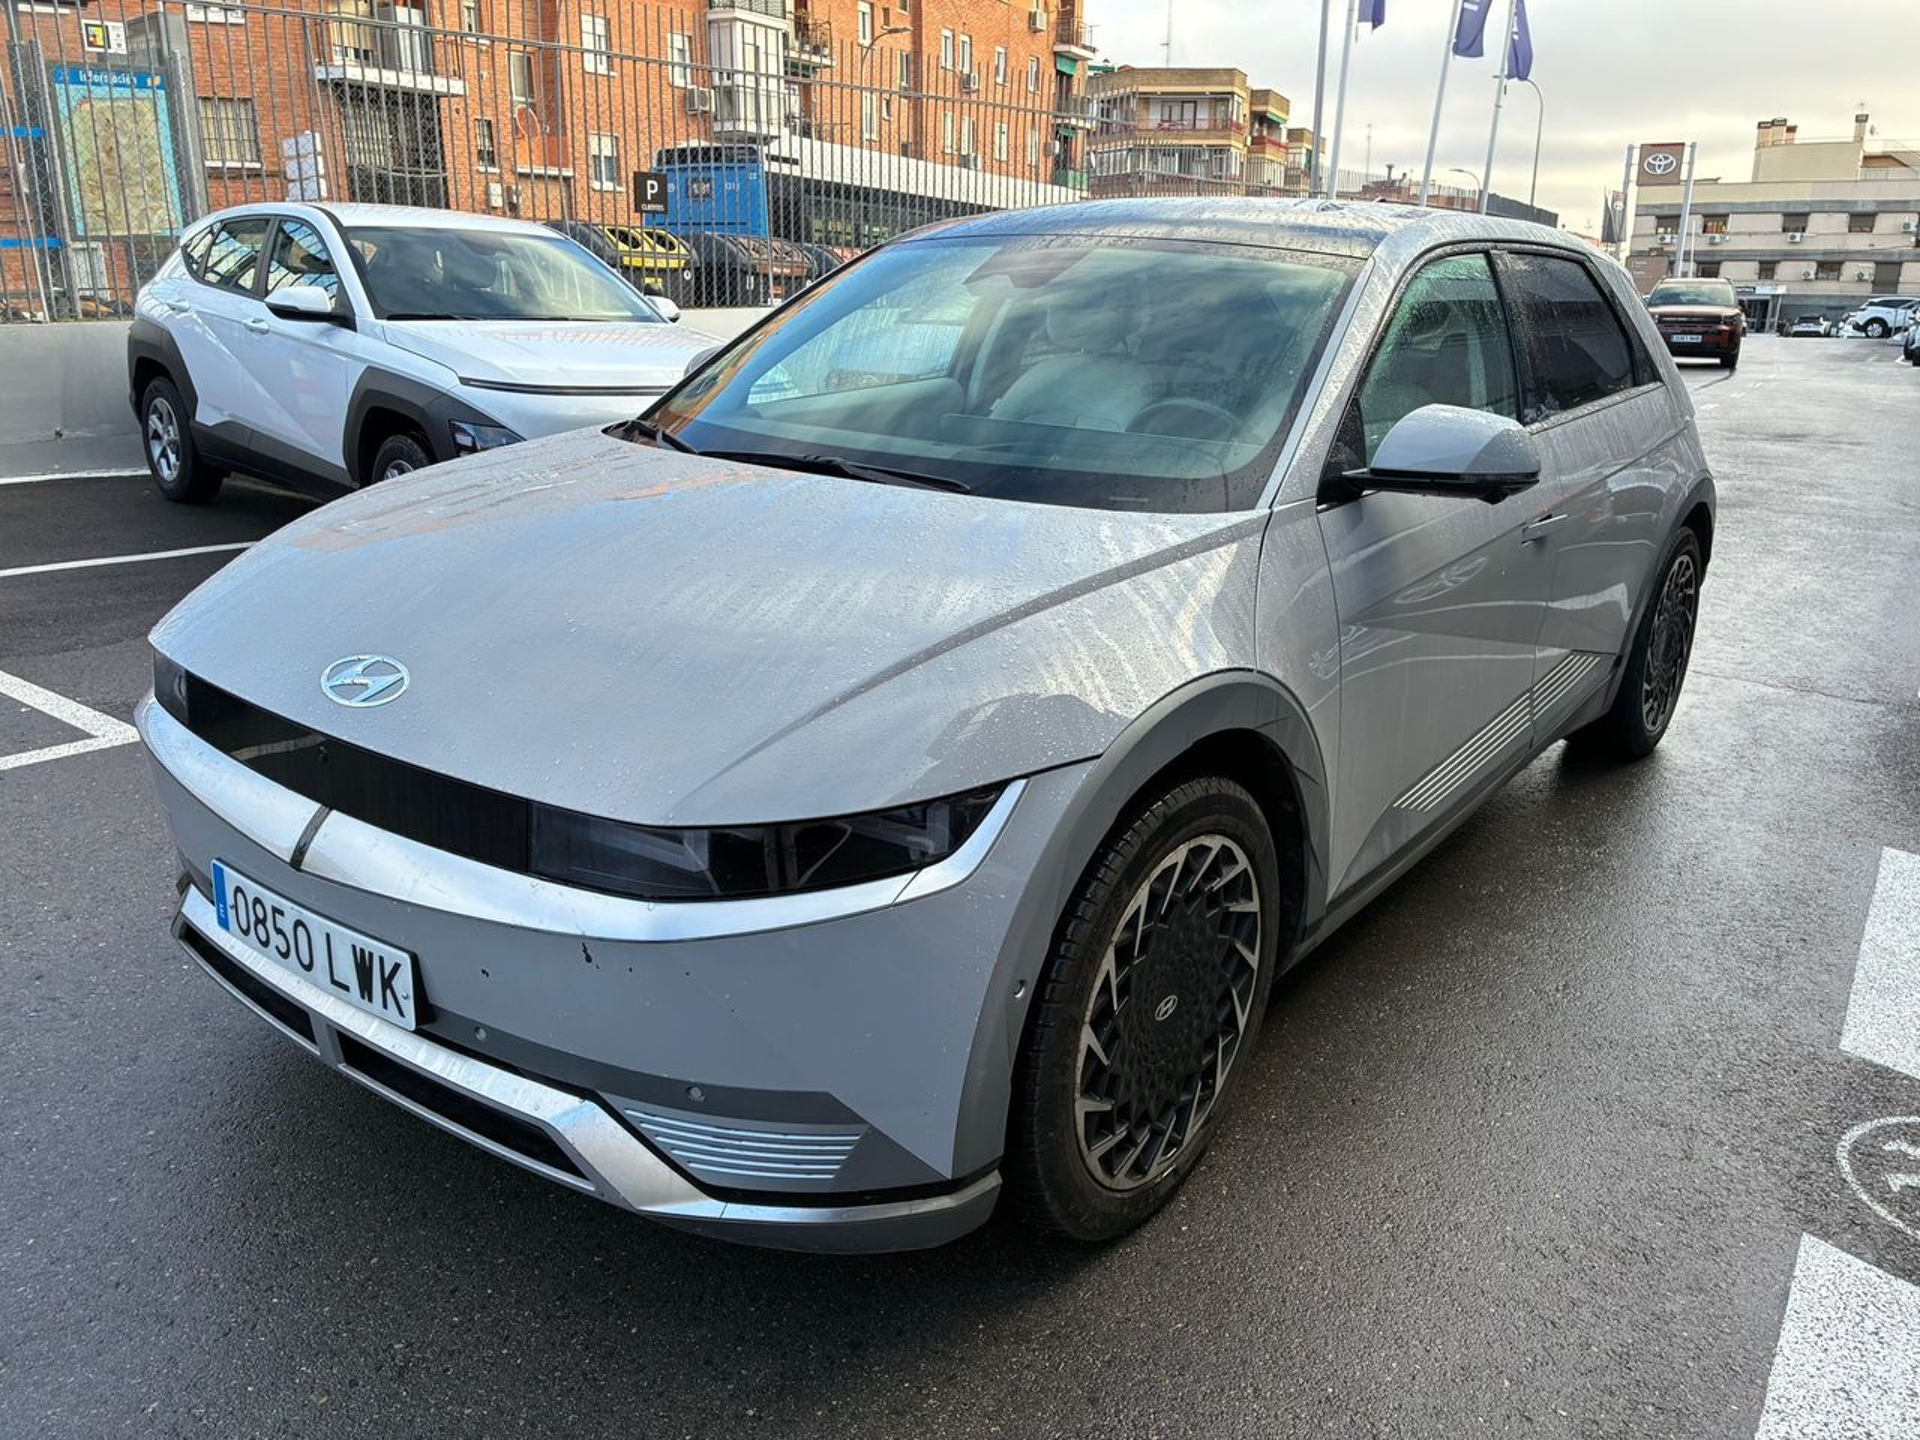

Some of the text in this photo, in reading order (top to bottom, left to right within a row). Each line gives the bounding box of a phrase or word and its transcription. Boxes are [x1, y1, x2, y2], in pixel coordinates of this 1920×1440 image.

[646, 179, 659, 201] P
[232, 885, 406, 1019] 0850 LWK
